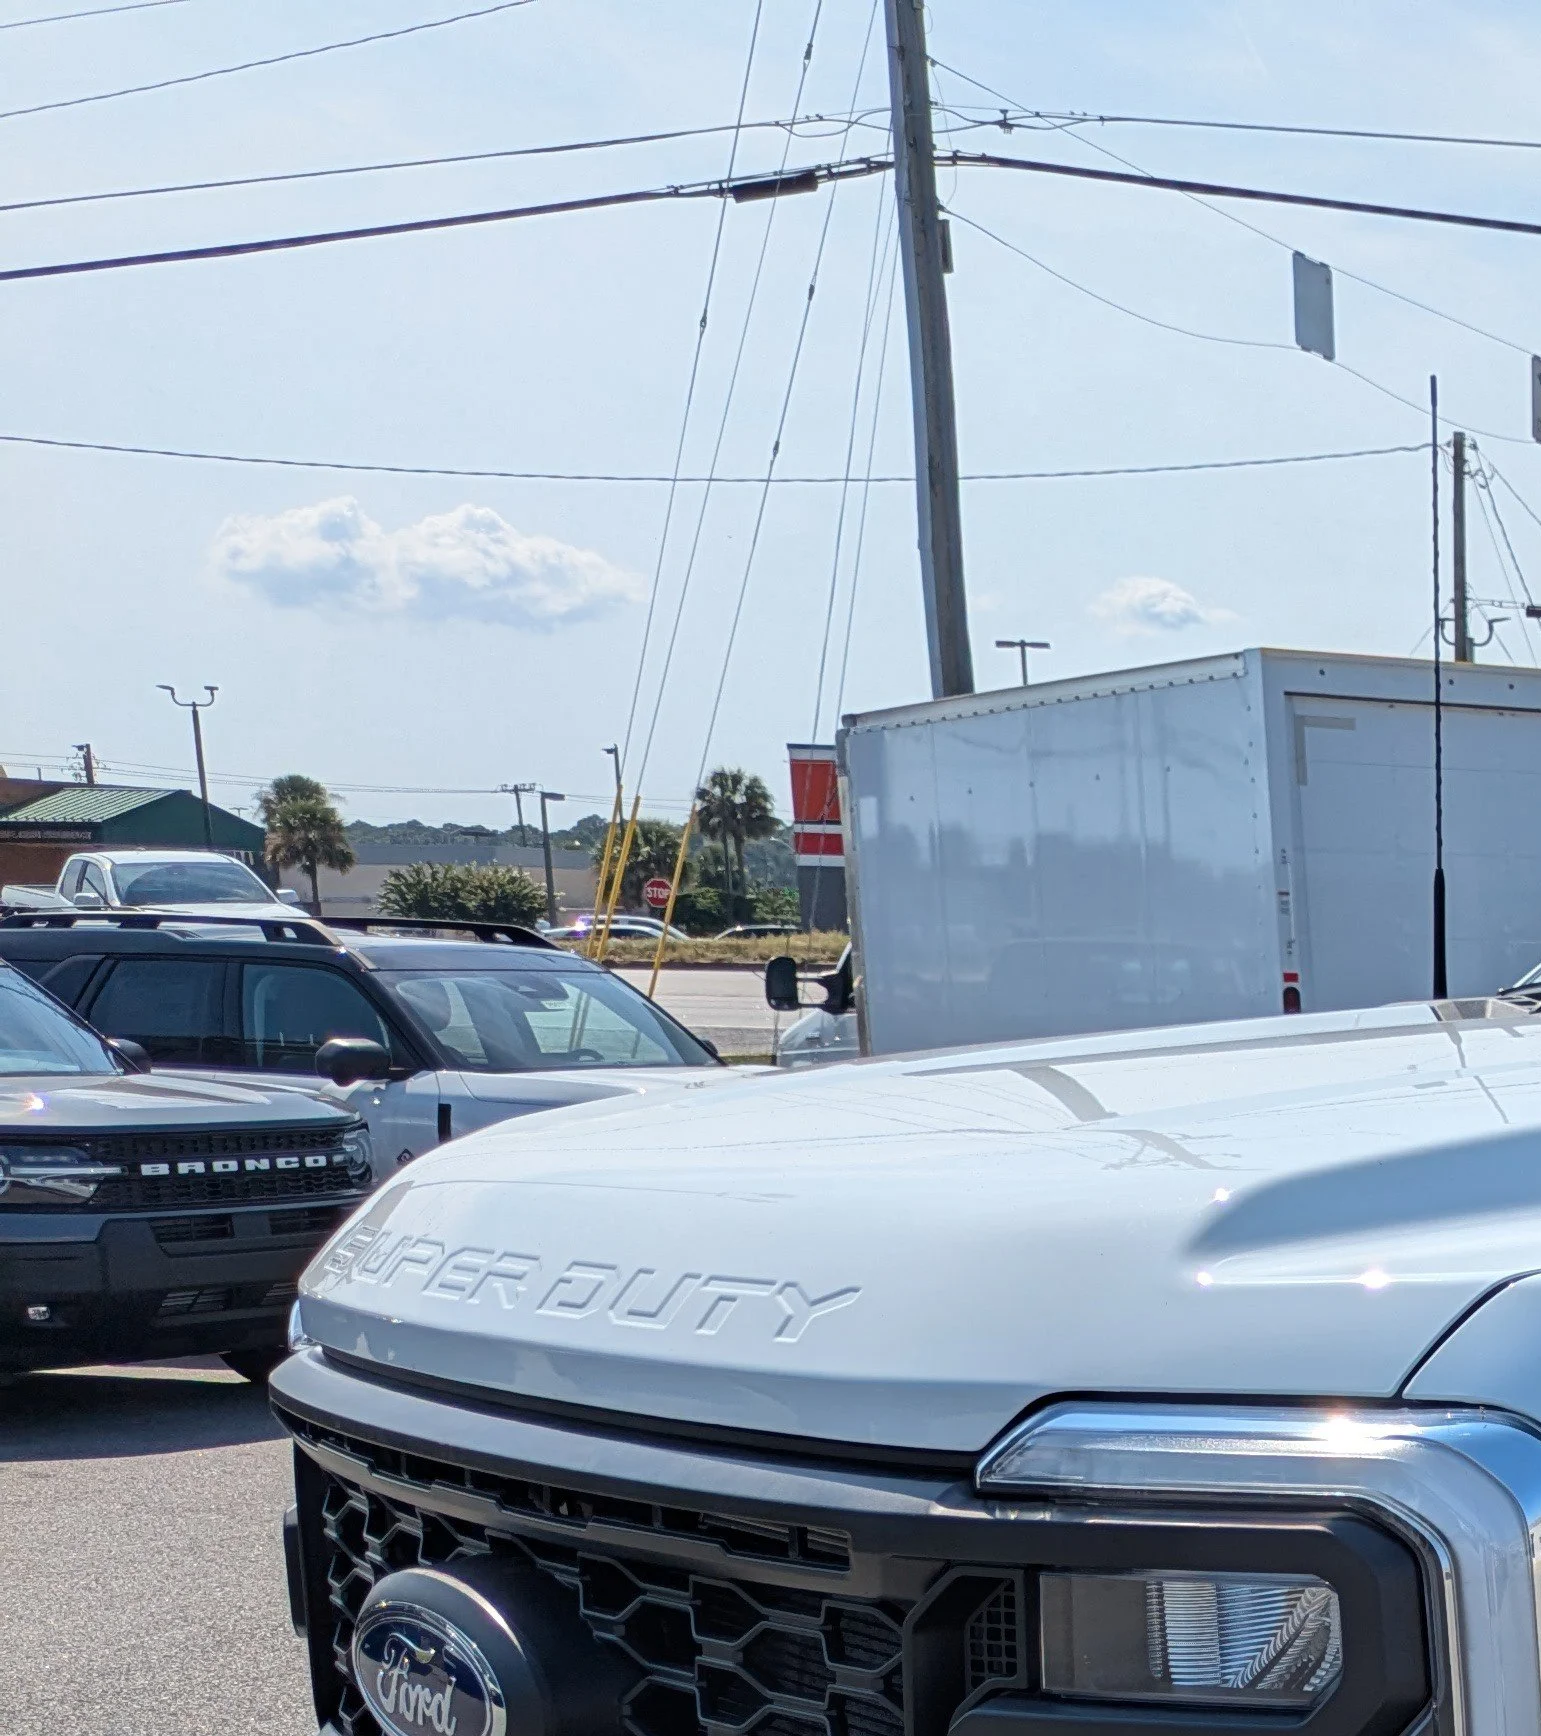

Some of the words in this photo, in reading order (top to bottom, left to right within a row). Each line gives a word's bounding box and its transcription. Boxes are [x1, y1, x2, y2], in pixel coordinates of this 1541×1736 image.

[140, 1155, 328, 1176] BRONCO
[535, 1260, 864, 1344] DUTY
[376, 1632, 457, 1736] Ford
